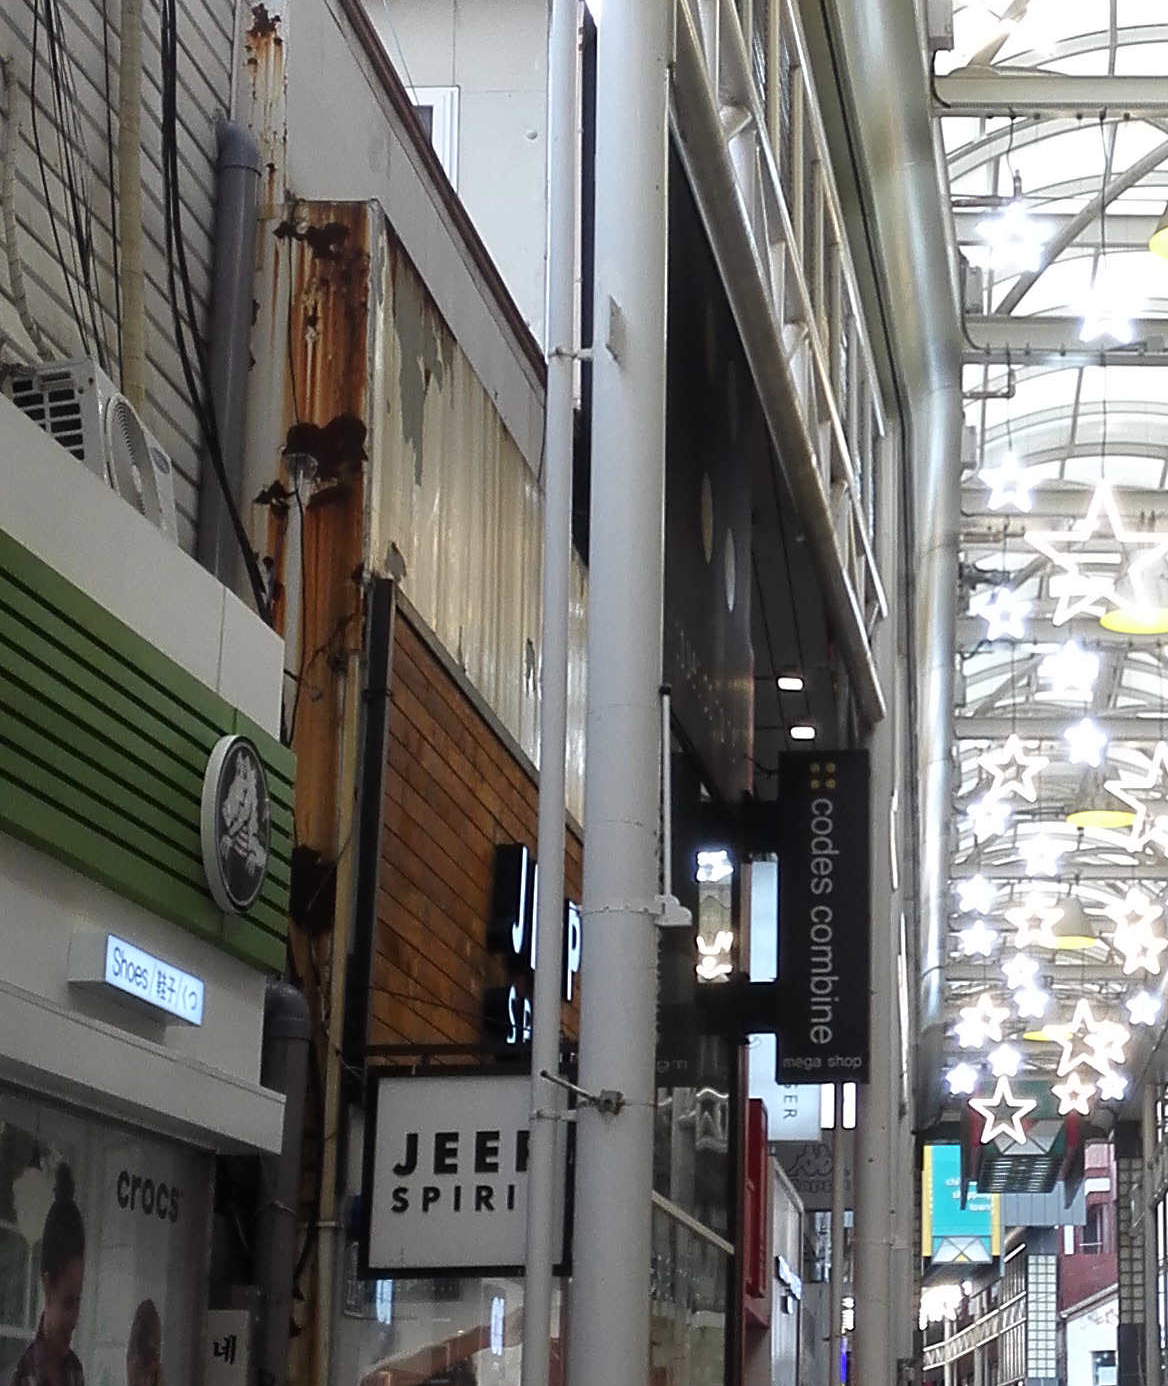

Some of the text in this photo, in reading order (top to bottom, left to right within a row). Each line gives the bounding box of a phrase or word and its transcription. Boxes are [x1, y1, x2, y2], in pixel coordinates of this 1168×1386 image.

[810, 798, 840, 1044] codes combine
[112, 946, 149, 990] Shoes
[782, 1054, 862, 1070] mega shop
[392, 1130, 530, 1176] JEE
[117, 1170, 179, 1224] crocs
[390, 1183, 516, 1213] SPIRI
